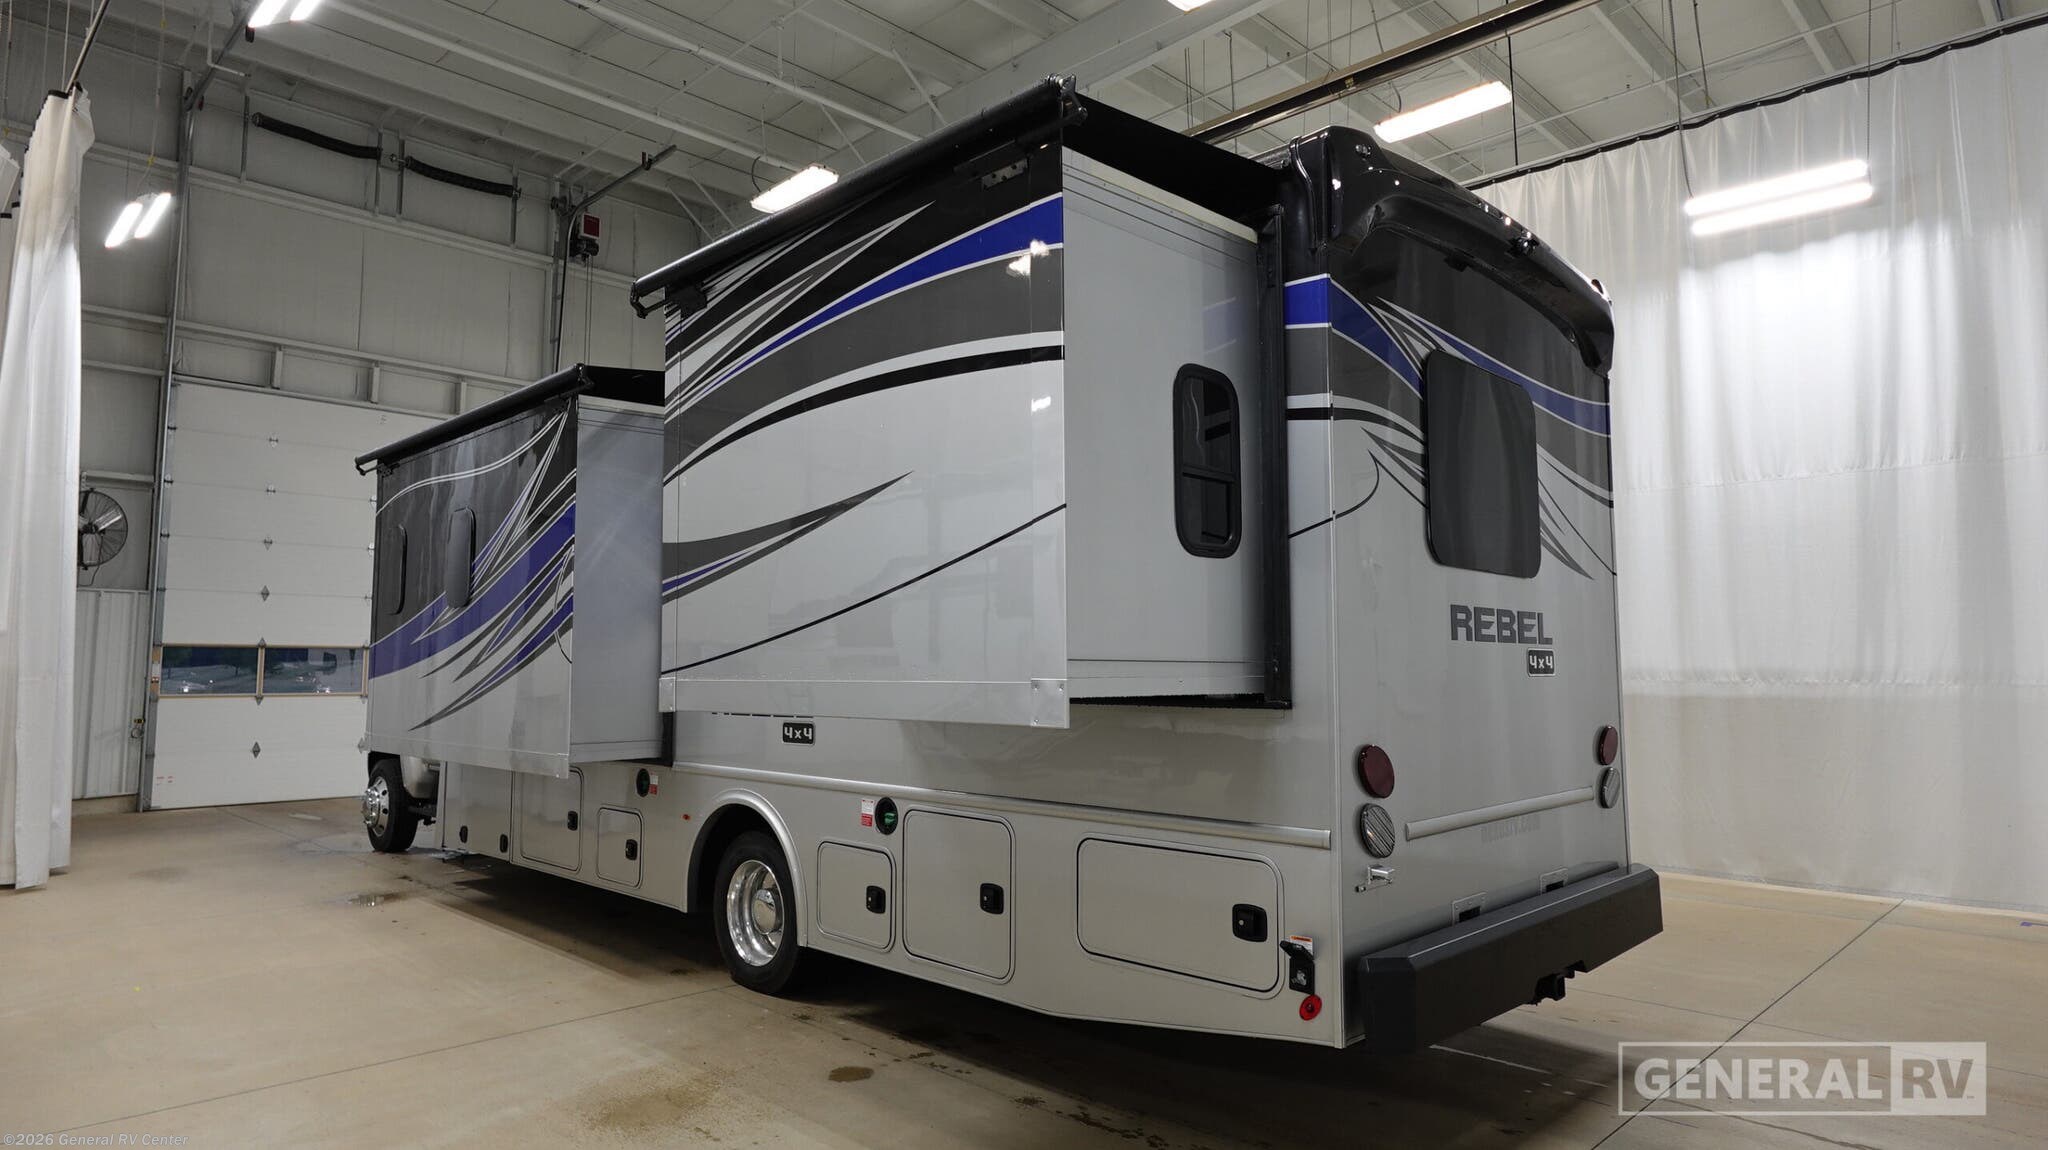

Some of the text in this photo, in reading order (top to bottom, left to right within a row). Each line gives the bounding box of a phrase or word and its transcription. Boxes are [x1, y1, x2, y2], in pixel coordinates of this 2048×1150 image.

[1450, 604, 1553, 645] REBEL
[1529, 655, 1553, 669] 4x4
[784, 726, 812, 740] 4x4
